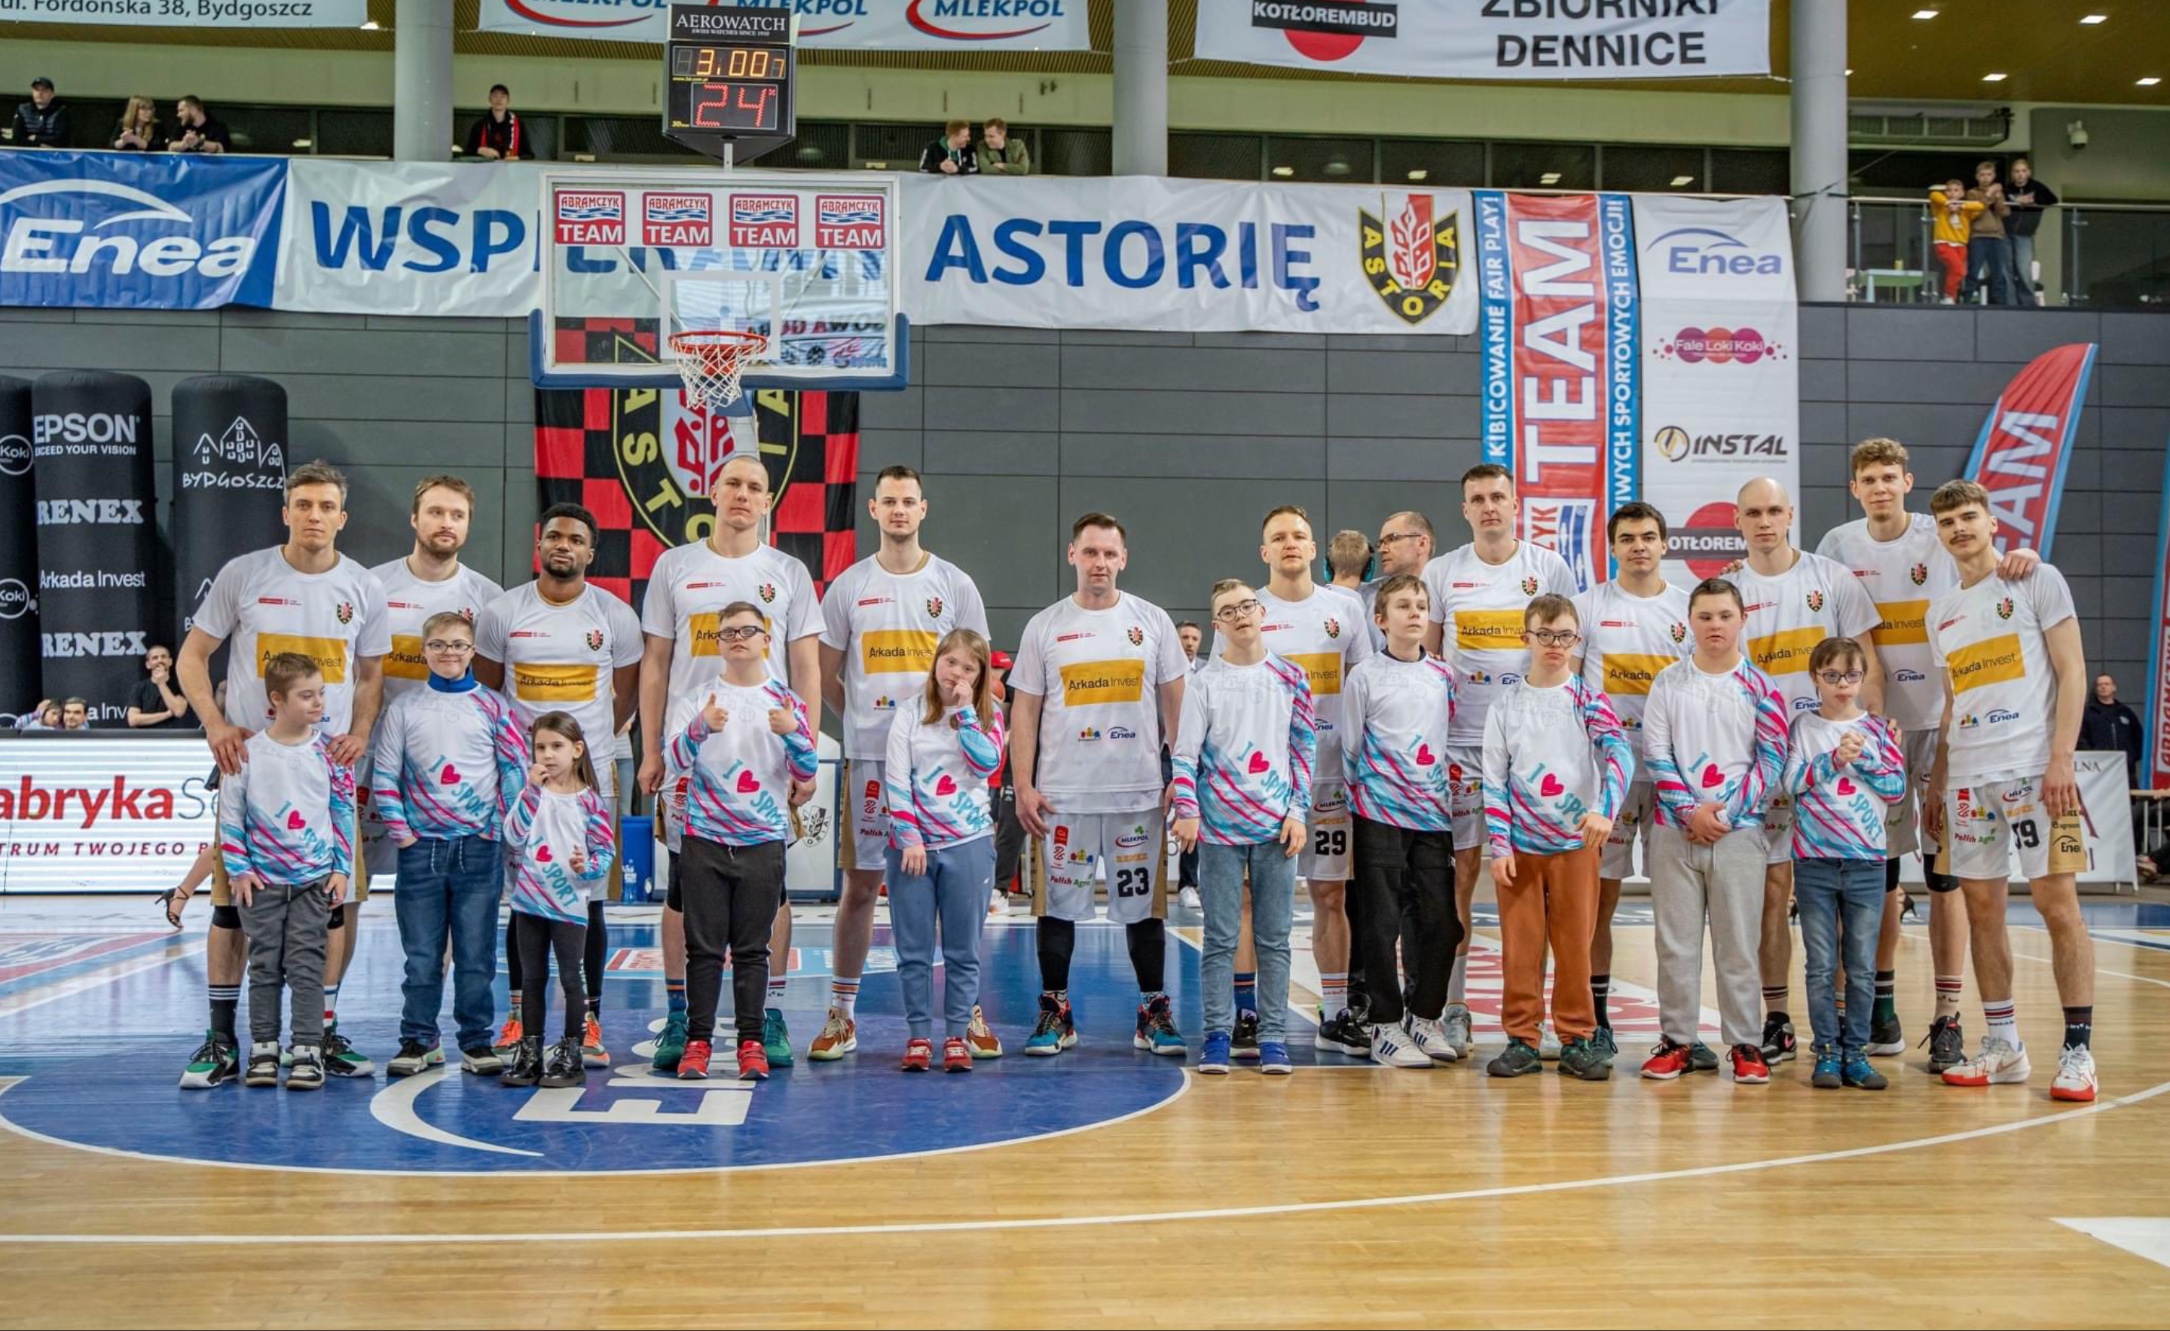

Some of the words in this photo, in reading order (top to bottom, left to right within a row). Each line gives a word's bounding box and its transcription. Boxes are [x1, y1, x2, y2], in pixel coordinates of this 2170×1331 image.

[158, 0, 191, 18] 38,
[198, 0, 313, 20] Bydgoszcz
[934, 0, 1065, 17] MLEKPOL
[1253, 2, 1394, 28] KOTŁOREMBUD
[676, 13, 786, 31] AEROWATCH
[1495, 32, 1706, 68] DENNICE
[695, 84, 768, 127] 24
[561, 196, 619, 209] ABRAMCZYK
[648, 197, 706, 210] ABRAMCZYK
[735, 199, 793, 211] ABRAMCZYK
[821, 200, 879, 212] ABRAMCZYK
[1482, 196, 1502, 251] PLAY!
[558, 224, 623, 243] TEAM
[646, 225, 710, 244] TEAM
[734, 227, 797, 245] TEAM
[820, 228, 883, 247] TEAM
[1, 216, 257, 278] Enea
[925, 214, 1321, 313] ASTORIĘ
[1668, 246, 1782, 275] Enea
[1364, 225, 1457, 316] ASTORIA
[1487, 257, 1506, 299] FAIR
[1518, 220, 1597, 484] TEAM
[1613, 282, 1632, 426] SPORTOWYCH
[1675, 339, 1704, 351] Fale
[1705, 340, 1733, 352] Loki
[1735, 340, 1764, 352] Koki
[1488, 305, 1507, 457] KIBICOWANIE
[33, 412, 137, 445] EPSON
[0, 445, 30, 459] Koki
[66, 444, 97, 455] YOUR
[101, 444, 137, 456] VISION
[1692, 434, 1788, 456] INSTAL
[182, 471, 284, 490] BYDGOSZCZ
[40, 570, 95, 589] Arkada
[98, 569, 146, 588] Invest
[1461, 625, 1500, 637] Arkada
[1893, 618, 1926, 630] Invest
[389, 652, 428, 665] Arkada
[870, 646, 906, 658] Arkada
[1757, 648, 1792, 665] Arkada
[1310, 669, 1338, 681] Invest
[1610, 668, 1652, 681] Arkada
[1952, 662, 1982, 681] Arkada
[1982, 652, 2017, 671] Invest
[1068, 678, 1110, 691] Arkada
[1110, 676, 1139, 688] Invest
[1897, 673, 1926, 682] Enea
[1795, 700, 1823, 711] Enea
[1989, 711, 2019, 724] Enea
[1110, 730, 1136, 740] Enea
[1848, 792, 1883, 842] SPORT
[859, 827, 883, 837] Polish
[74, 841, 186, 858] TWOJEGO
[1314, 829, 1347, 856] 29
[543, 862, 579, 907] SPORT
[1116, 866, 1150, 898] 23
